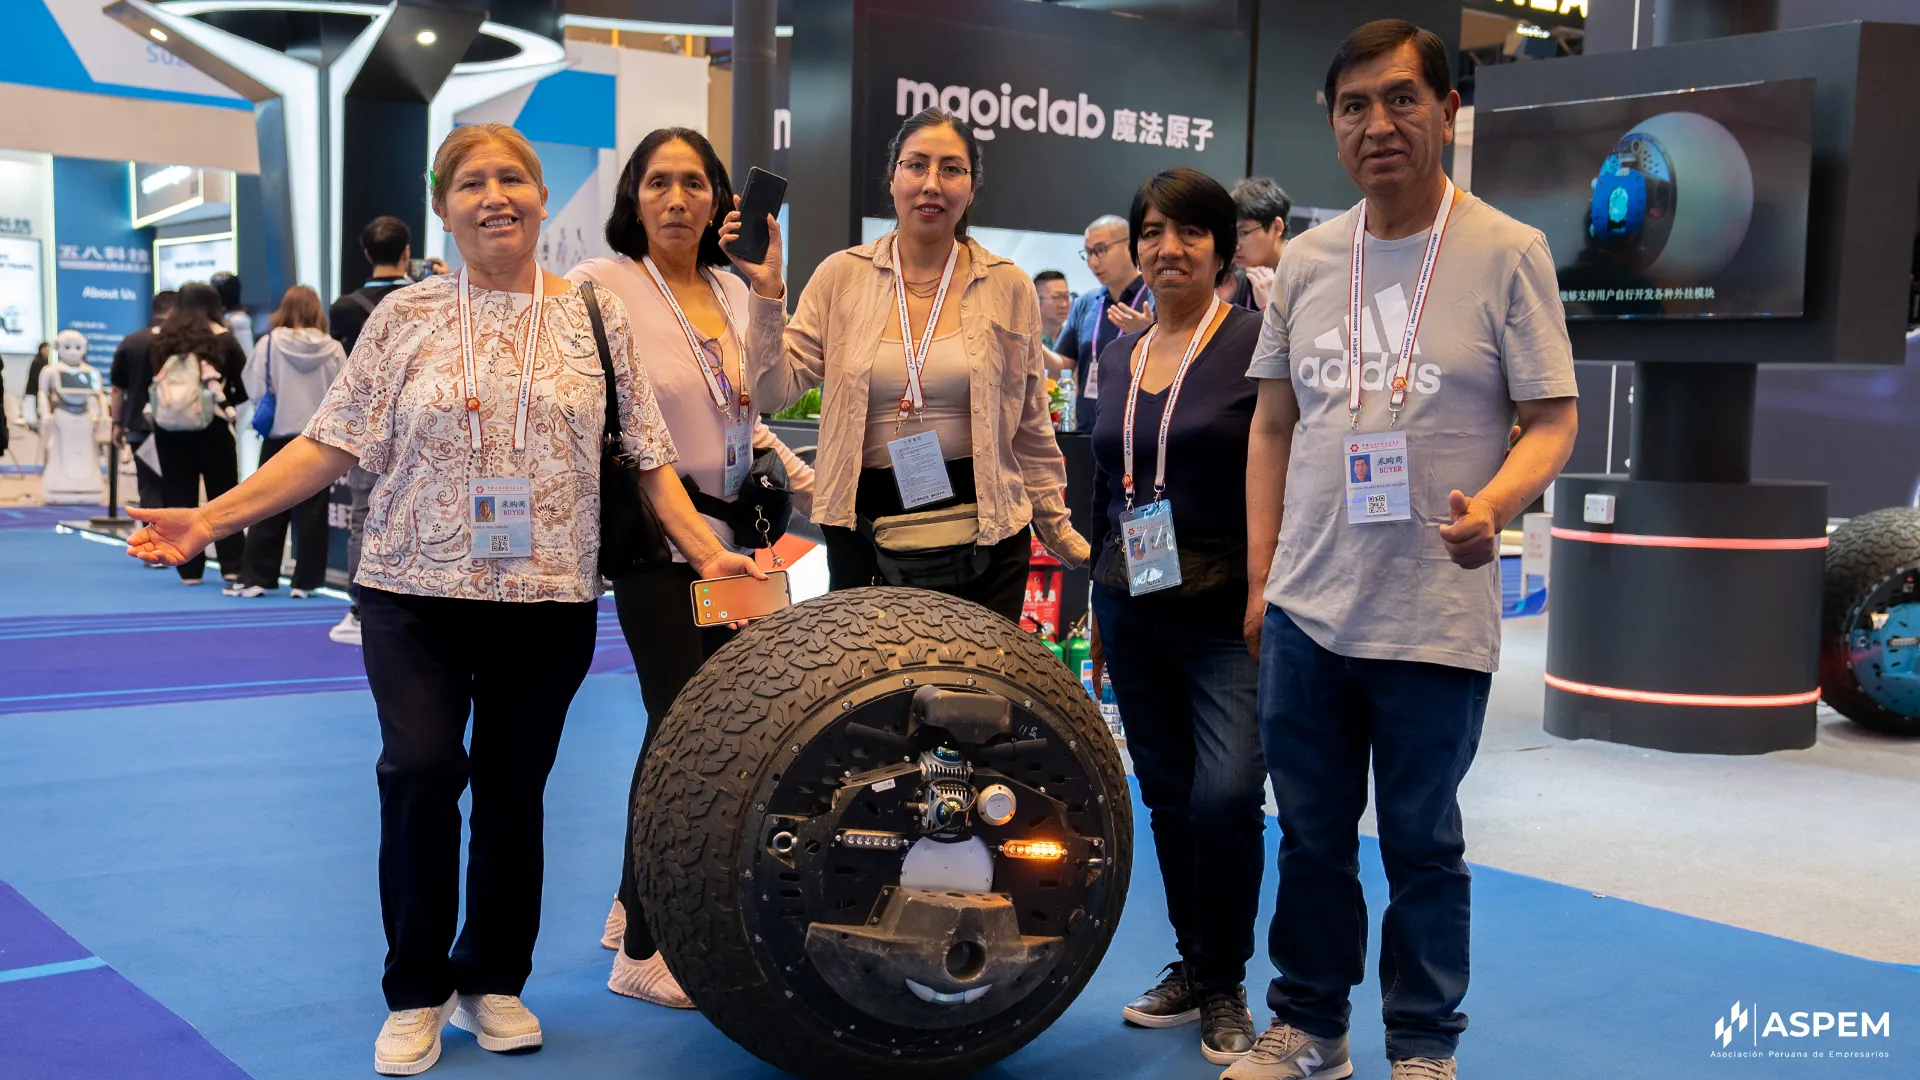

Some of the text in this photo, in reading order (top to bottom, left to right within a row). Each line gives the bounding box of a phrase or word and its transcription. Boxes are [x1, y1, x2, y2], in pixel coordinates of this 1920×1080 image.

[1111, 108, 1214, 152] 魔法原子
[82, 286, 137, 301] About Us
[1298, 350, 1441, 394] addas
[1377, 455, 1403, 466] 采购商
[1379, 466, 1402, 474] BUYER
[501, 500, 526, 509] 采购商
[1294, 1046, 1325, 1078] N
